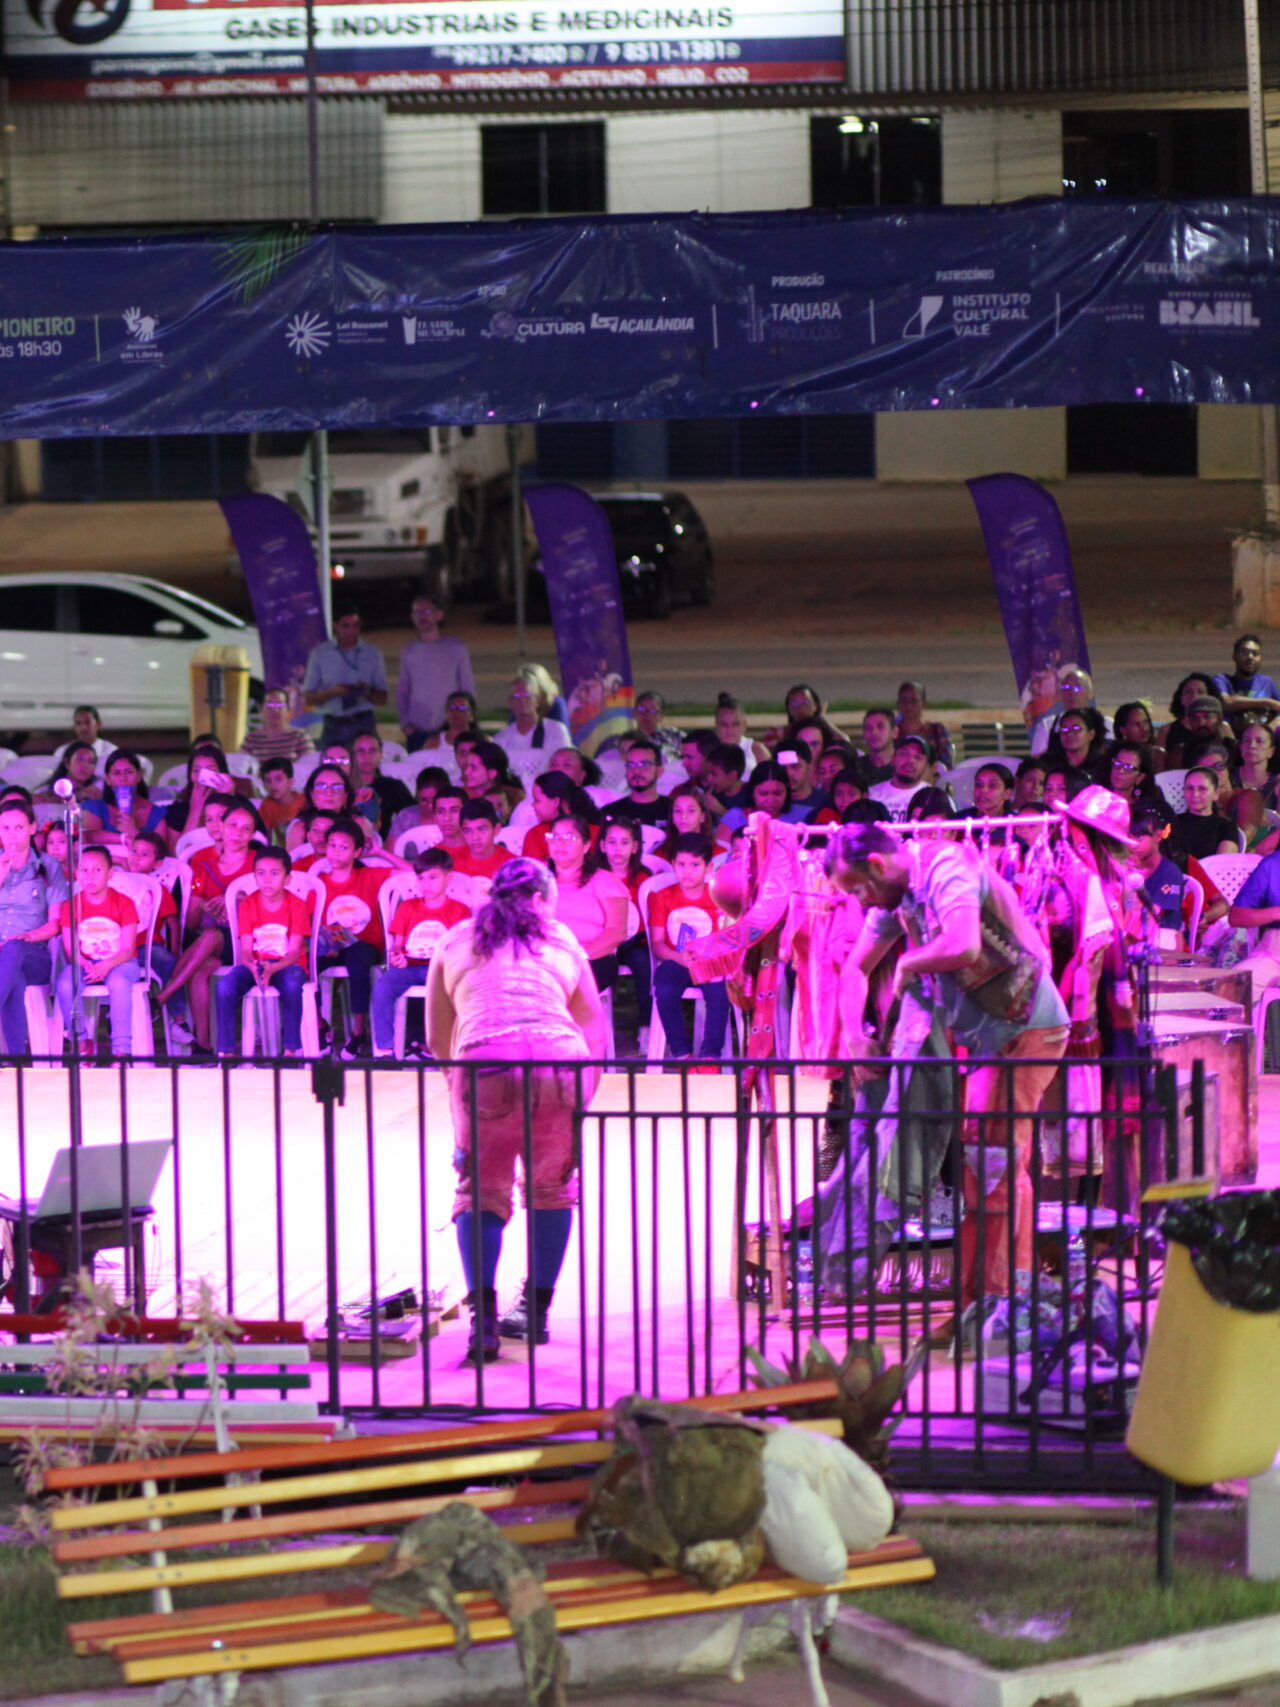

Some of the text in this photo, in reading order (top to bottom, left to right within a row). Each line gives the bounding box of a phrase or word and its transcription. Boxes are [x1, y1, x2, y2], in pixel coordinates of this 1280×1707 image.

[332, 12, 518, 36] INDUSTRIAIS
[530, 12, 548, 32] E
[559, 8, 732, 31] MEDICINAIS
[771, 272, 825, 287] PRODUÇÃO
[935, 268, 995, 282] PATROCÍNIO
[477, 285, 507, 296] APOIO
[952, 293, 1031, 306] INSTITUTO
[770, 301, 842, 323] TAQUARA
[953, 308, 1030, 321] CULTURAL
[1160, 299, 1260, 326] BRASIL
[517, 321, 585, 336] CULTURA
[619, 316, 694, 333] AÇAILÂNDIA
[954, 325, 991, 337] VALE
[18, 340, 62, 357] 18h30
